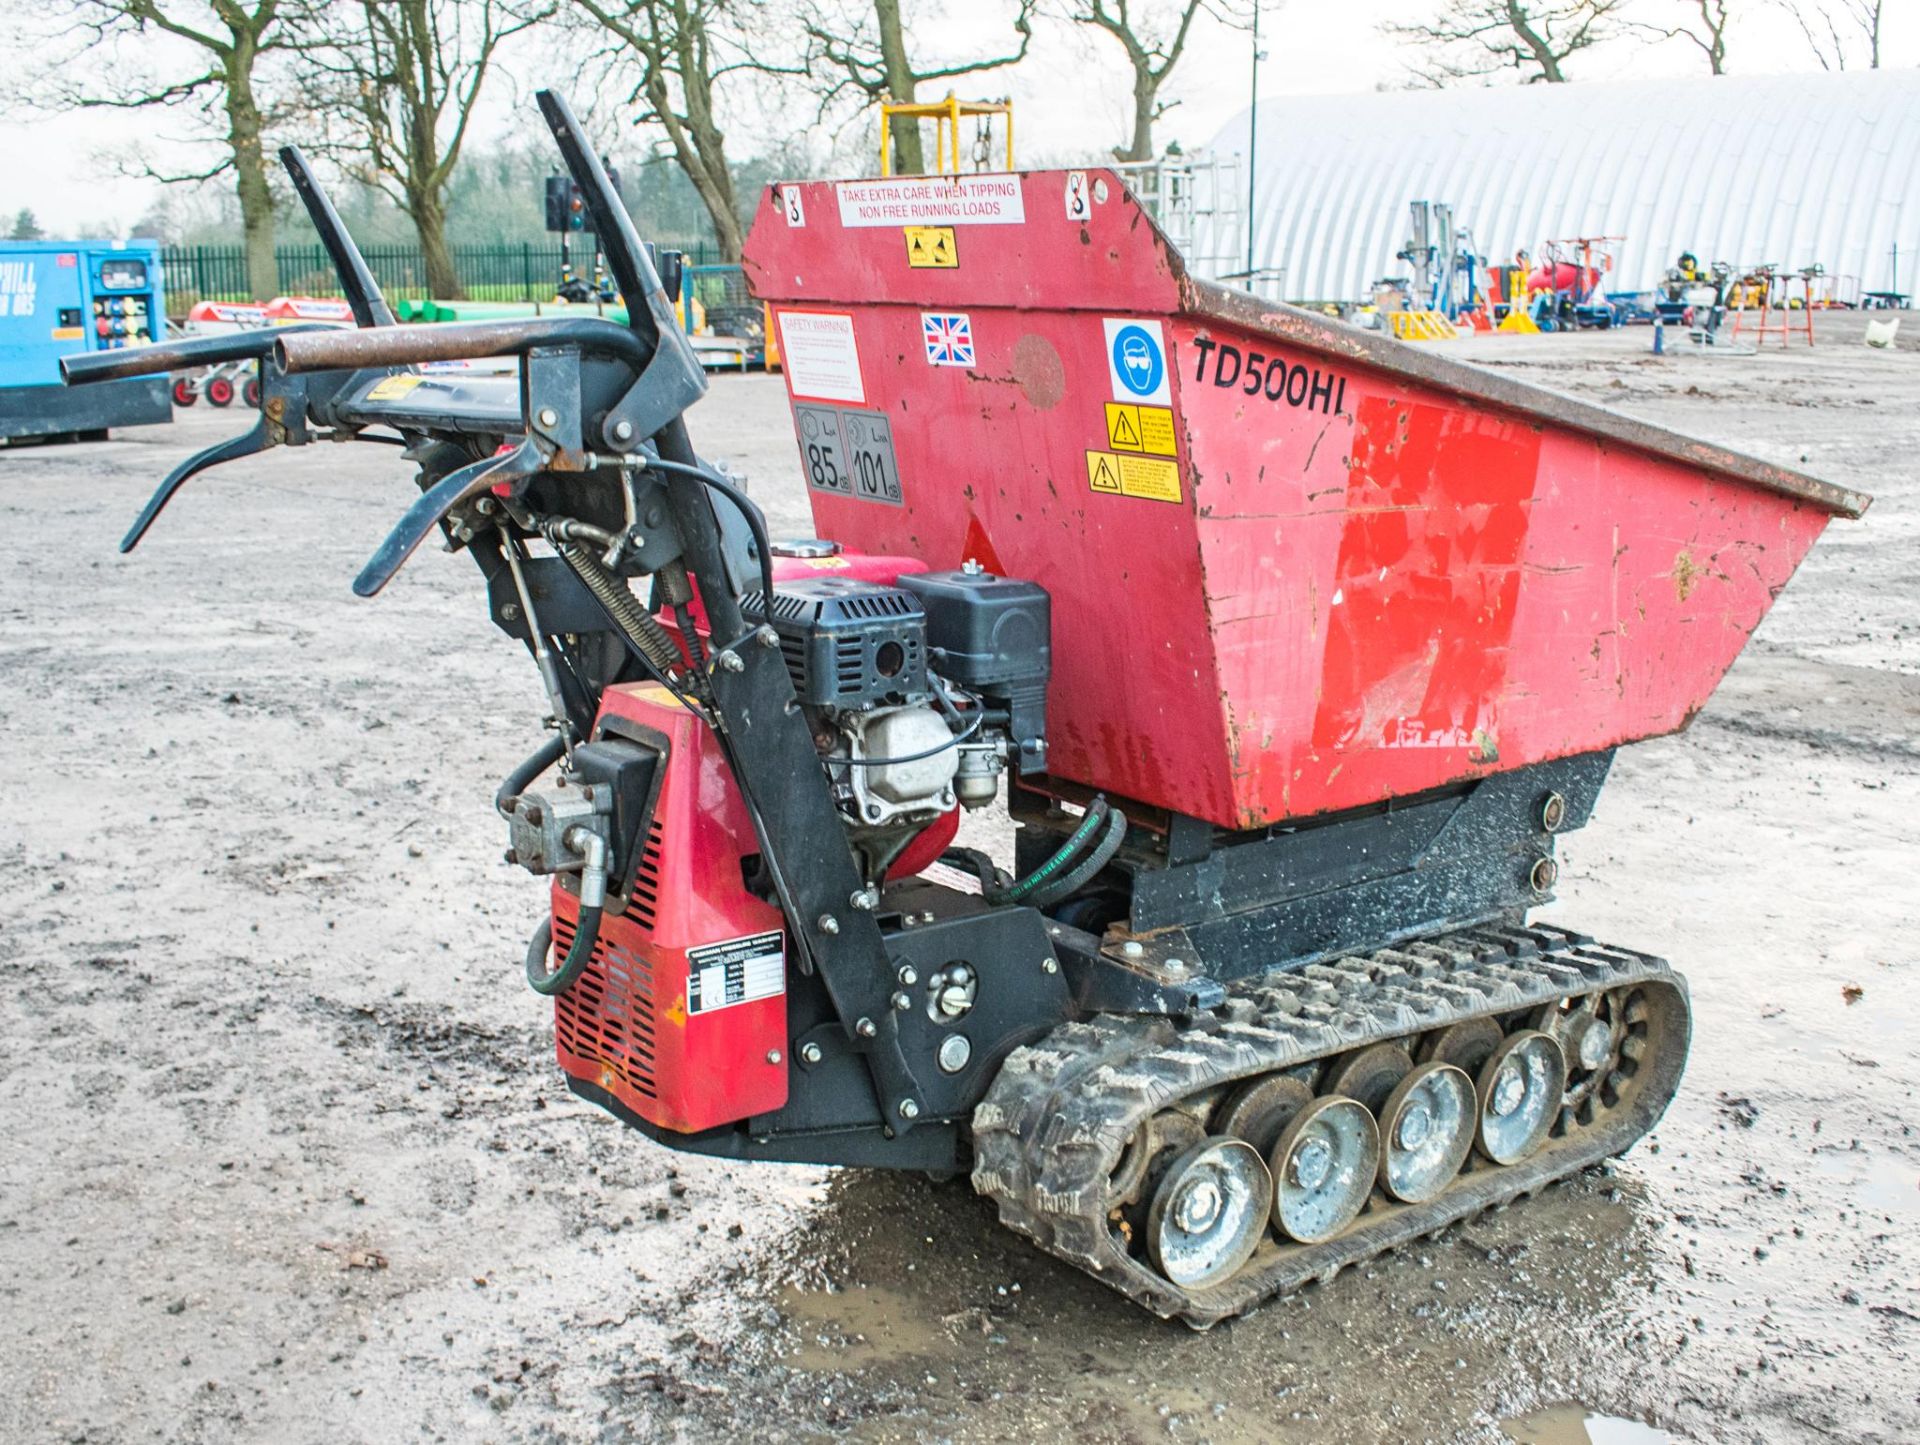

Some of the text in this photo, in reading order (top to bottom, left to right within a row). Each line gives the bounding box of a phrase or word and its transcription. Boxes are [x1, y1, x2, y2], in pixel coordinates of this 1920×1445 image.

[843, 182, 1016, 203] TAKE EXTRA CARE WHEN TIPPING
[859, 201, 1001, 219] NON FREE RUNNING LOADS
[784, 317, 849, 334] SAFETY WARNING
[808, 443, 838, 488] 85
[854, 450, 888, 496] 101
